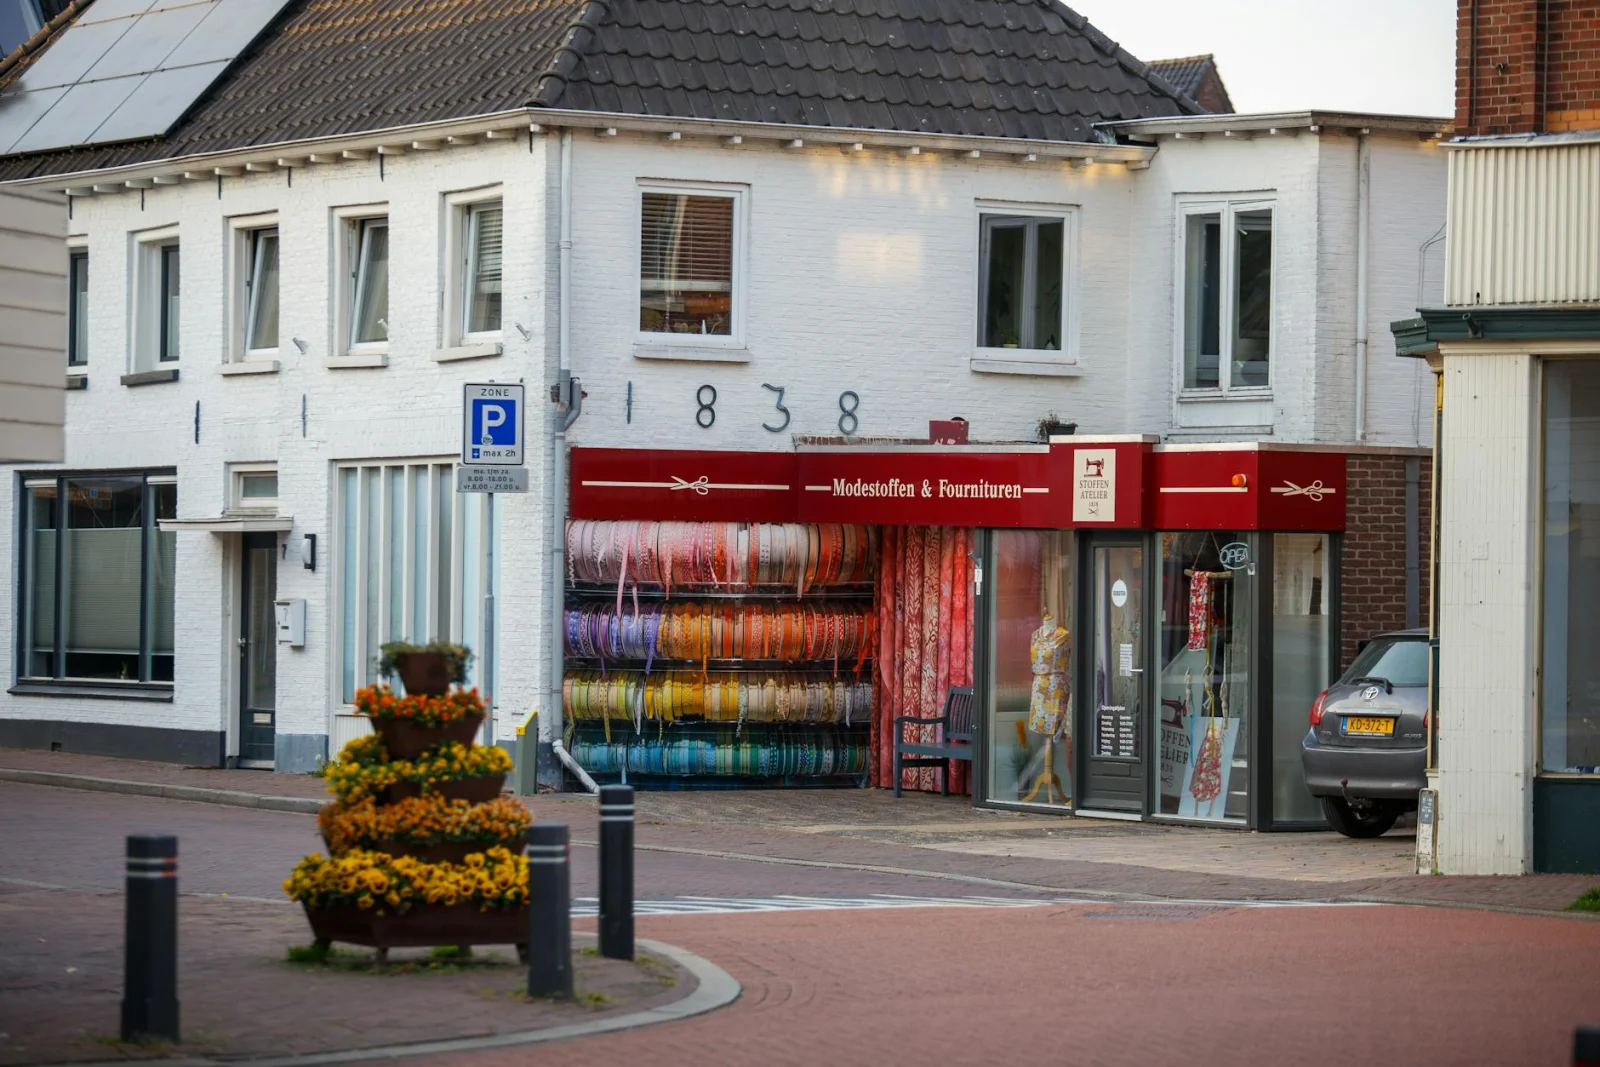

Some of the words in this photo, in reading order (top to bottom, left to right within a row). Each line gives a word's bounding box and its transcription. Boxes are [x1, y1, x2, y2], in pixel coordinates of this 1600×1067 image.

[481, 388, 509, 396] ZONE
[482, 404, 506, 439] P
[505, 449, 516, 457] 2h
[832, 478, 915, 497] Modestoffen
[920, 479, 932, 498] &
[938, 479, 1022, 499] Fournituren
[1080, 480, 1109, 489] STOFFEN
[1080, 490, 1108, 499] ATELIER
[1349, 720, 1391, 731] KD-372-T
